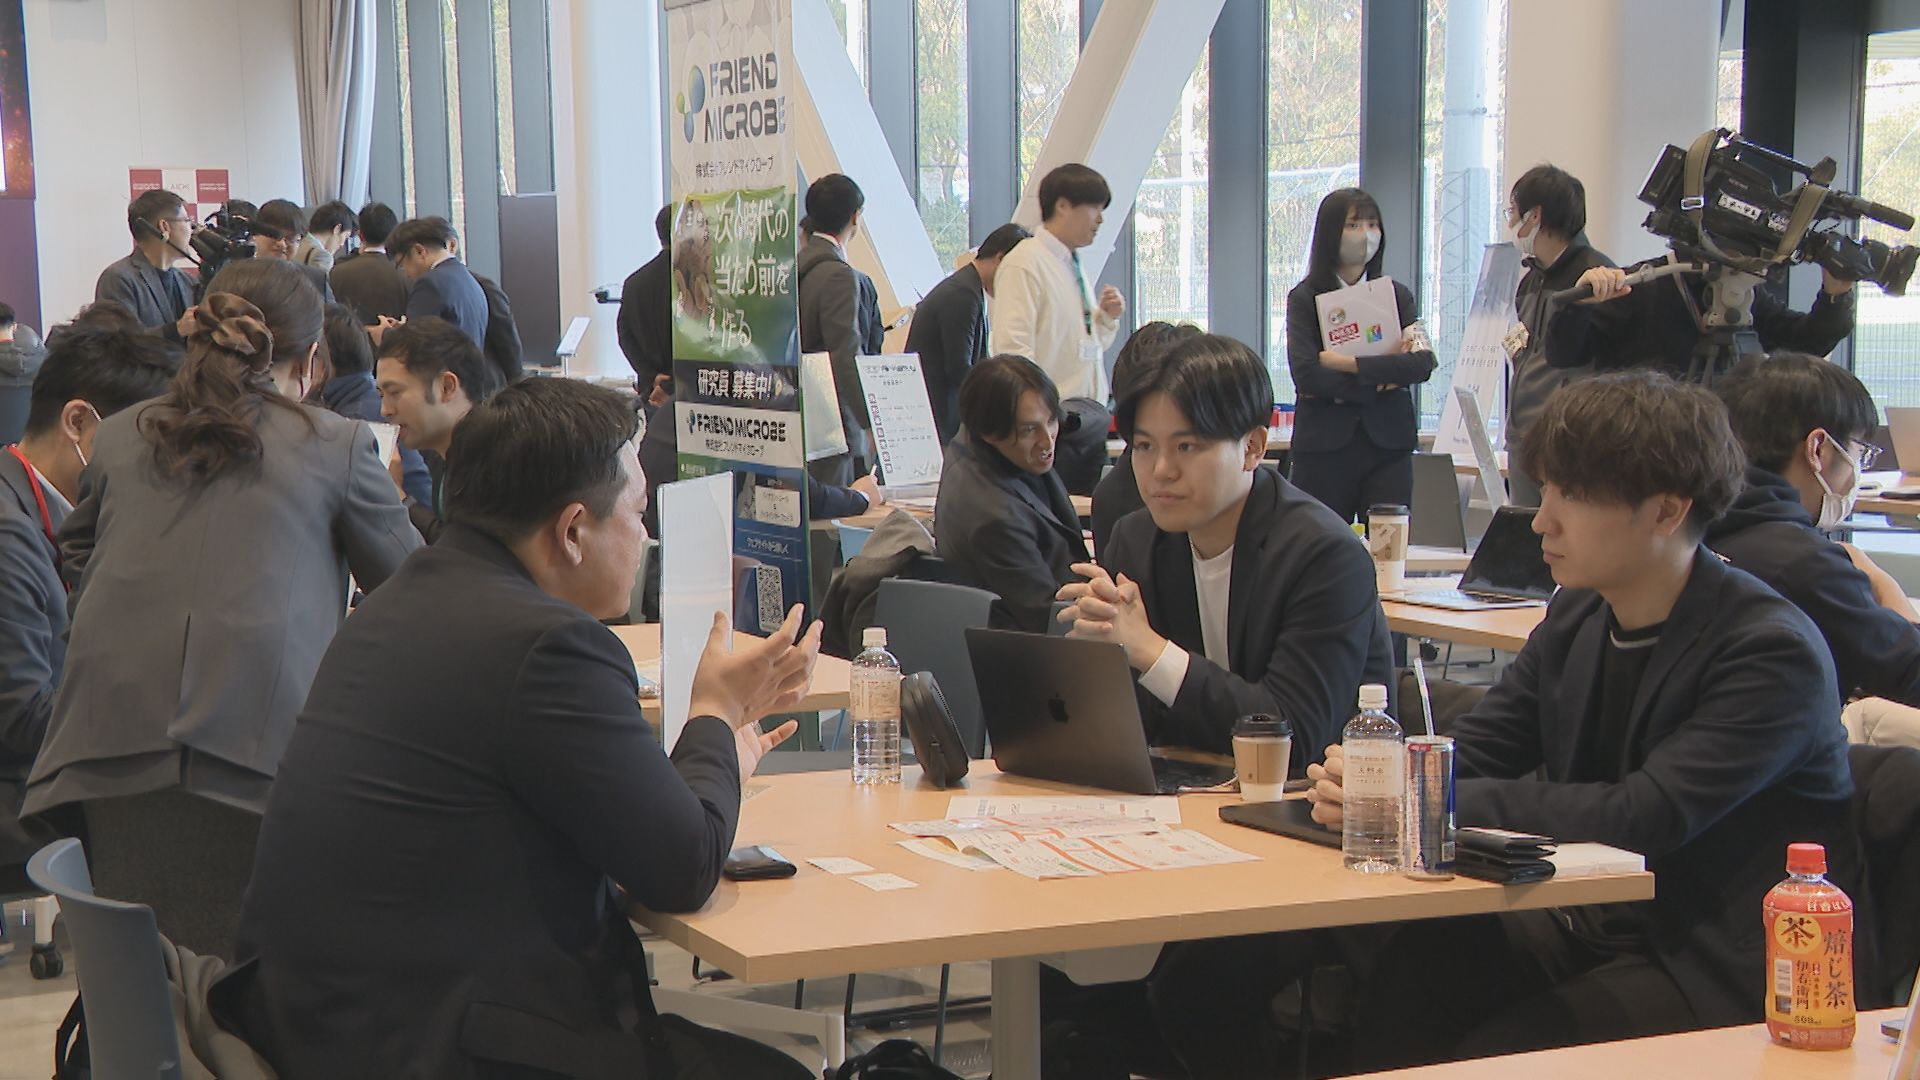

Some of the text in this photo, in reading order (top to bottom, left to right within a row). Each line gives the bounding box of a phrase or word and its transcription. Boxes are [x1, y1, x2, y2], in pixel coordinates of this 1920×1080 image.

[709, 52, 778, 97] FRIEND
[704, 96, 786, 144] MICROBE
[714, 199, 789, 244] 次の時代の
[714, 252, 790, 298] 当たり前を
[721, 306, 752, 349] 作る
[697, 368, 772, 401] 研究員 募集中!
[696, 413, 787, 442] FRIEND MICROBE
[1780, 917, 1815, 949] 茶
[1823, 928, 1849, 1010] 焙じ茶
